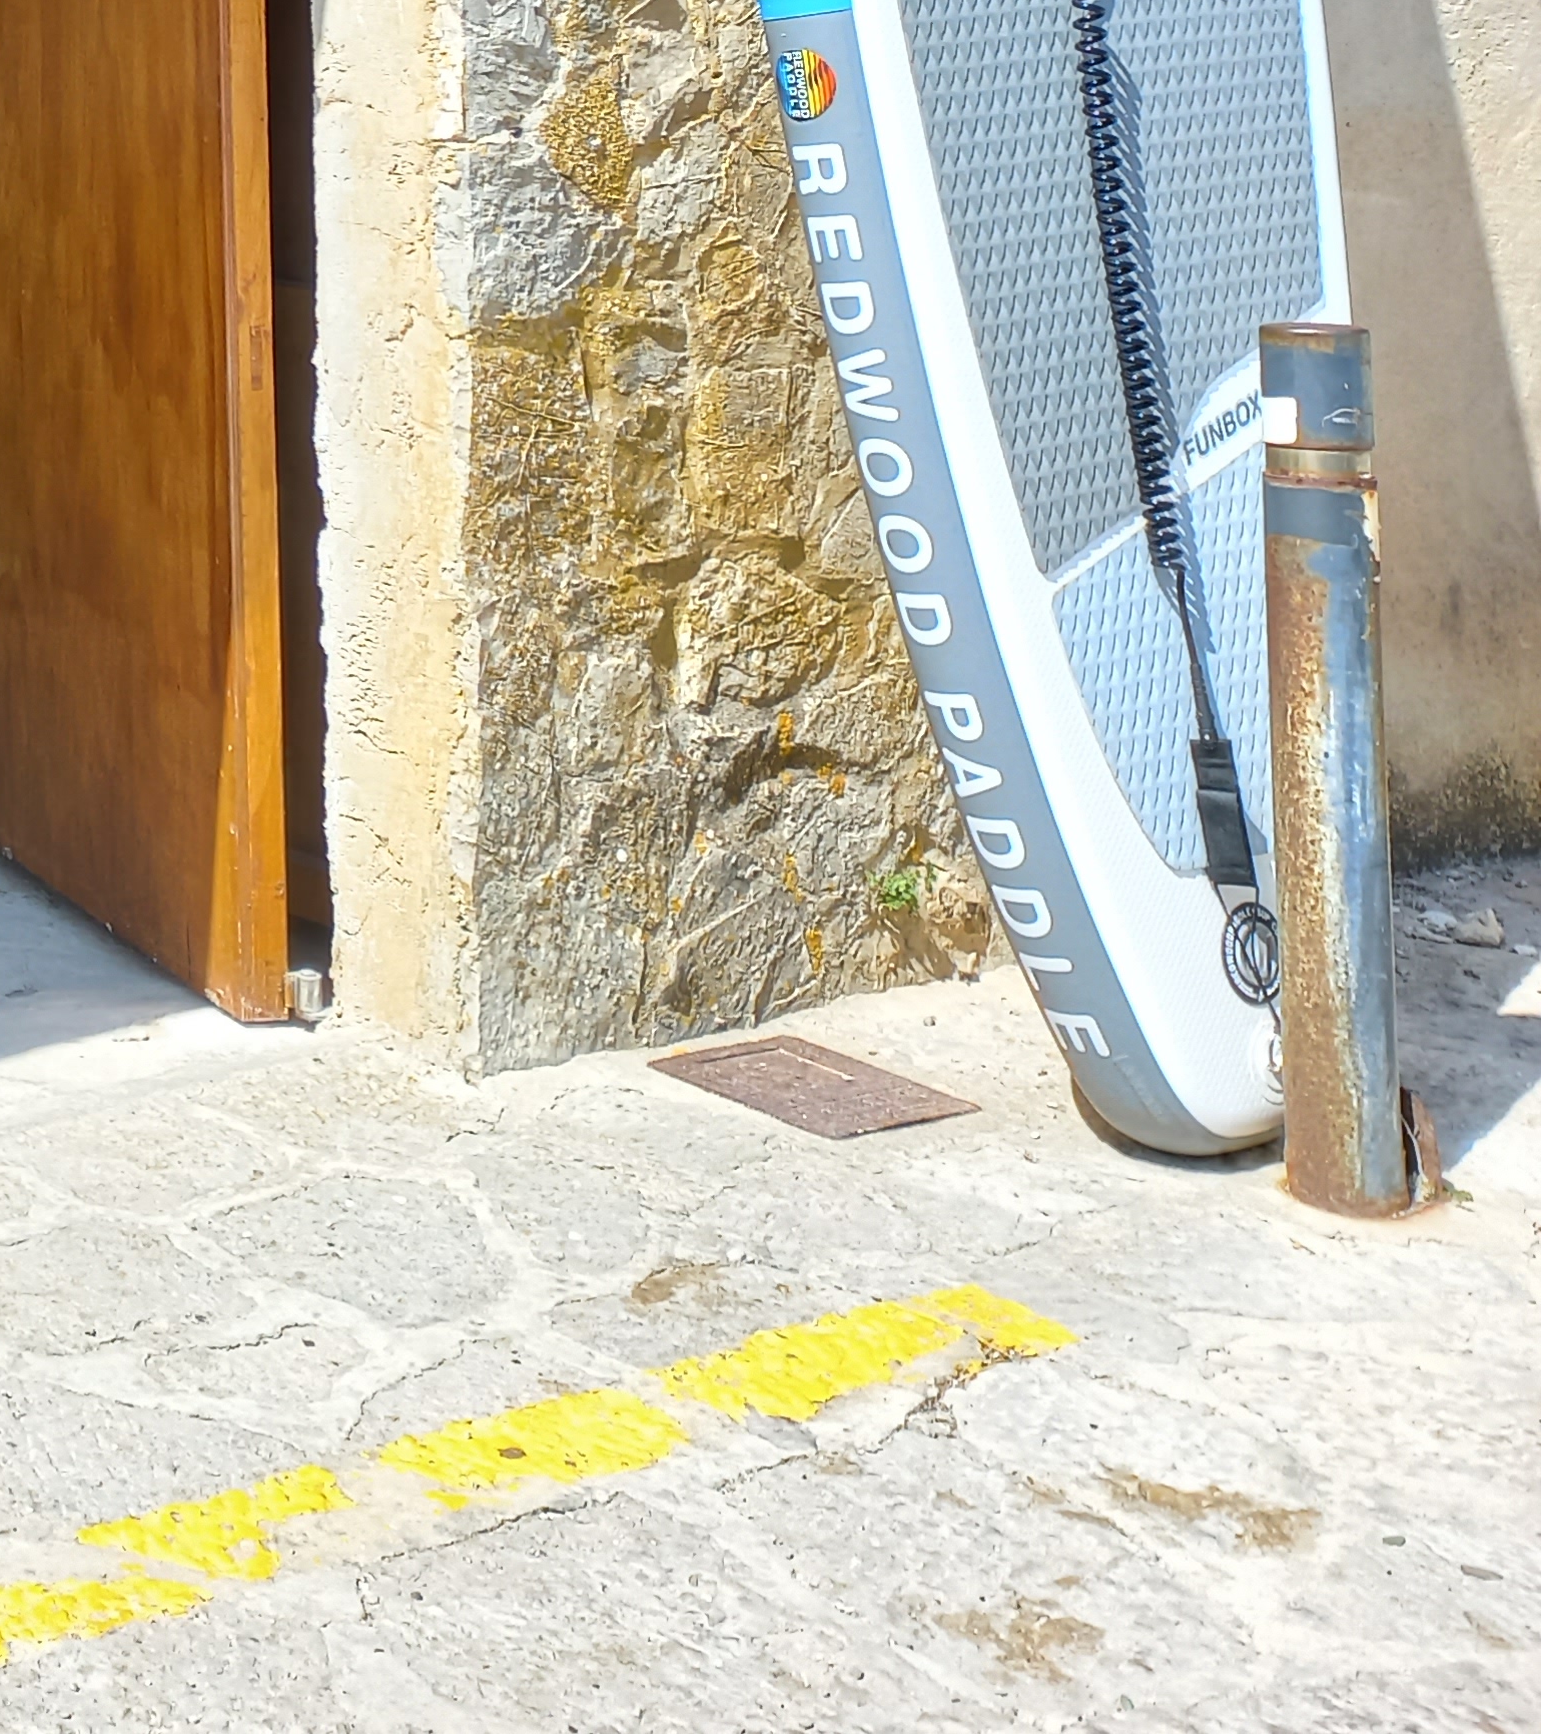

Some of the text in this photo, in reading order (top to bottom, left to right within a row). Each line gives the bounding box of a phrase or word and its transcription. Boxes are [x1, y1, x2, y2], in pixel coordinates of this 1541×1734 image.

[782, 52, 801, 118] PADDLE
[791, 51, 810, 119] REDWOOD
[1182, 388, 1263, 466] FUNBOX
[791, 141, 1112, 1059] REDWOOD PADDLE
